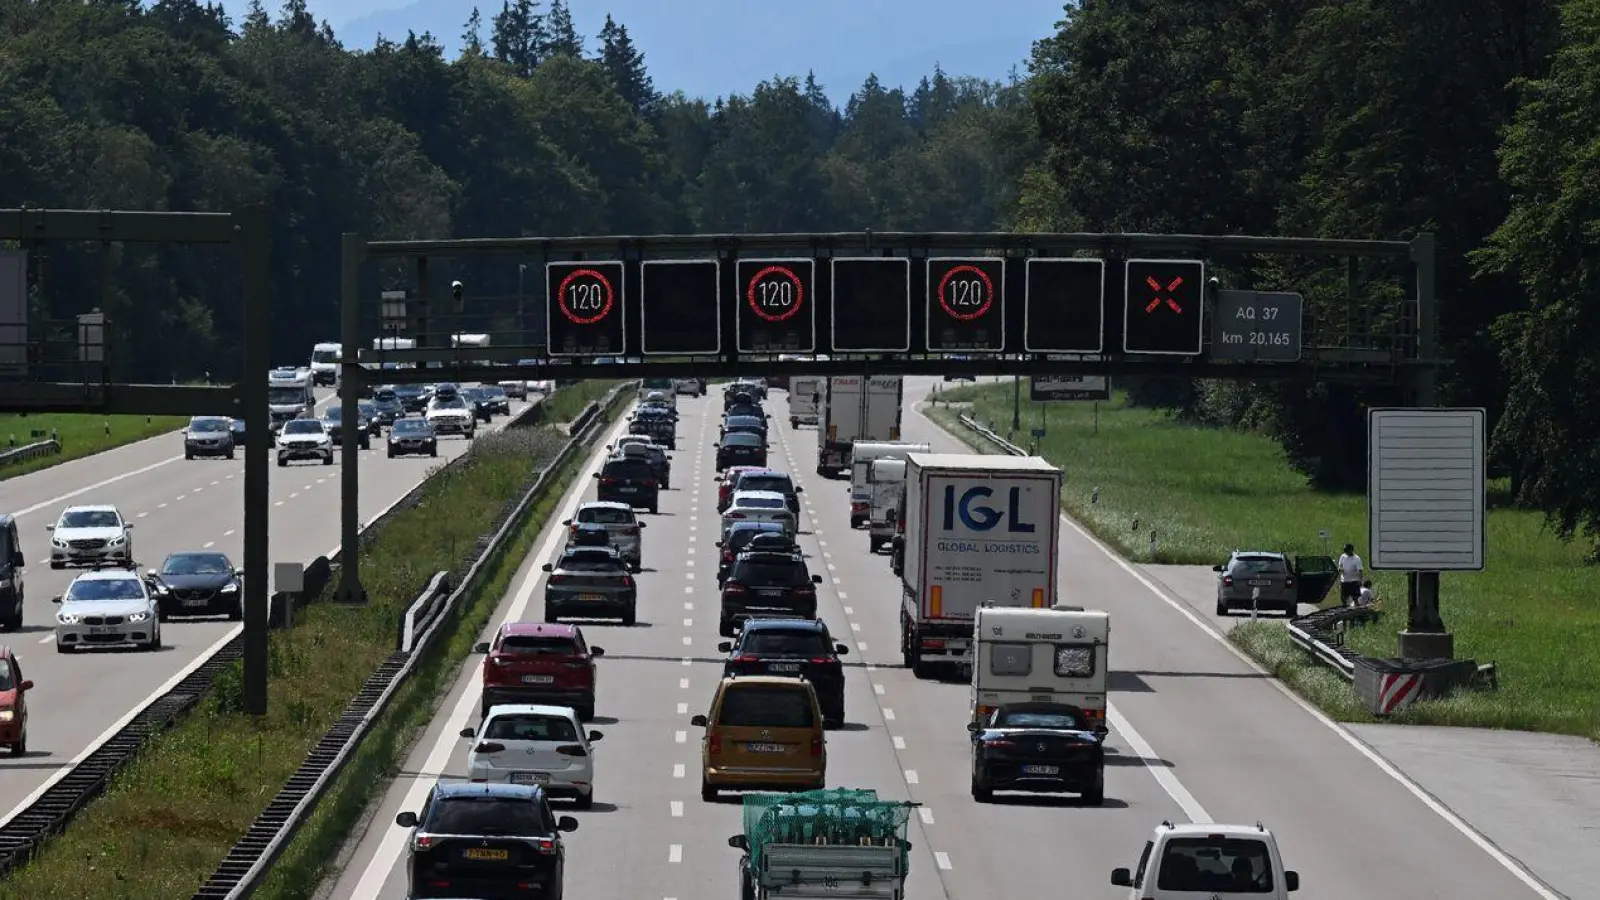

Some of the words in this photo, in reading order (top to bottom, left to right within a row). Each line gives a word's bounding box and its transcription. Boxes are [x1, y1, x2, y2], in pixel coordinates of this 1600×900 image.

[569, 284, 601, 310] 120
[758, 281, 792, 306] 120
[950, 279, 982, 306] 120
[1235, 306, 1256, 320] AQ
[1262, 306, 1279, 320] 37
[1222, 330, 1243, 344] km
[1249, 332, 1289, 345] 20,165
[943, 485, 1035, 532] IGL
[937, 542, 980, 552] GLOBAL
[985, 544, 1040, 554] LOGISTICS
